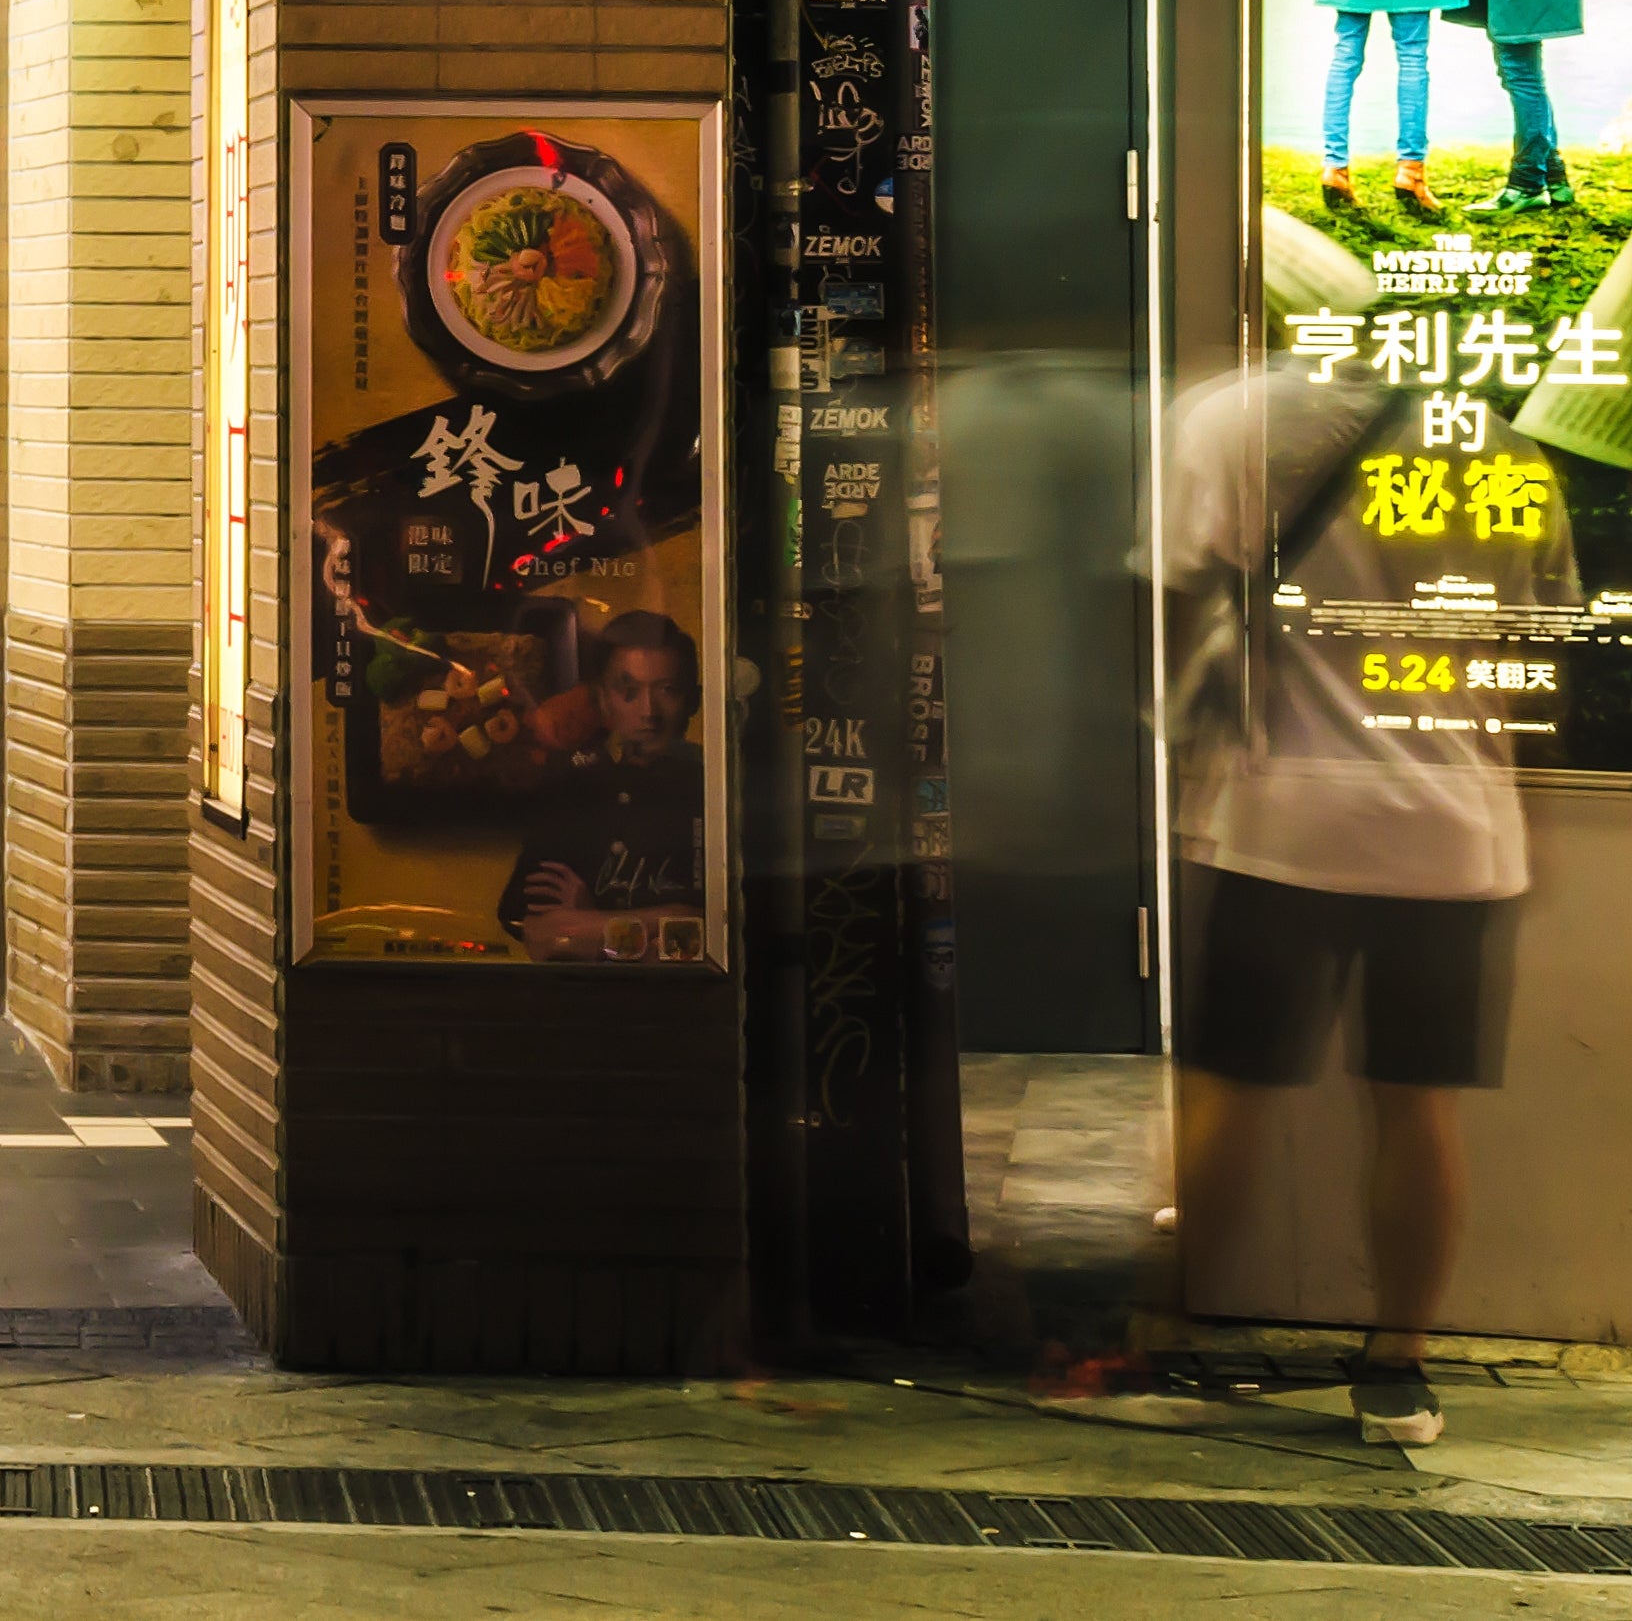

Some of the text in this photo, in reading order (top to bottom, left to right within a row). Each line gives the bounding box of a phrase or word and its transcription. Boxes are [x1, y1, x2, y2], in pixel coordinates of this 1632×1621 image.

[805, 235, 885, 258] ZEMOK
[1431, 233, 1472, 251] THE
[1372, 250, 1534, 274] MYSTERY OF
[1376, 273, 1533, 296] HENRI PICK
[1283, 306, 1630, 386] 亨利先生
[810, 407, 890, 429] ZEMOK
[1421, 389, 1488, 454] 的
[825, 463, 882, 480] ARDE
[410, 405, 594, 589] 鋒味
[1359, 453, 1552, 540] 秘密
[408, 552, 453, 575] 限定
[1361, 652, 1558, 694] 5.24 笑翻天
[804, 716, 868, 759] 24K
[815, 771, 869, 800] LR
